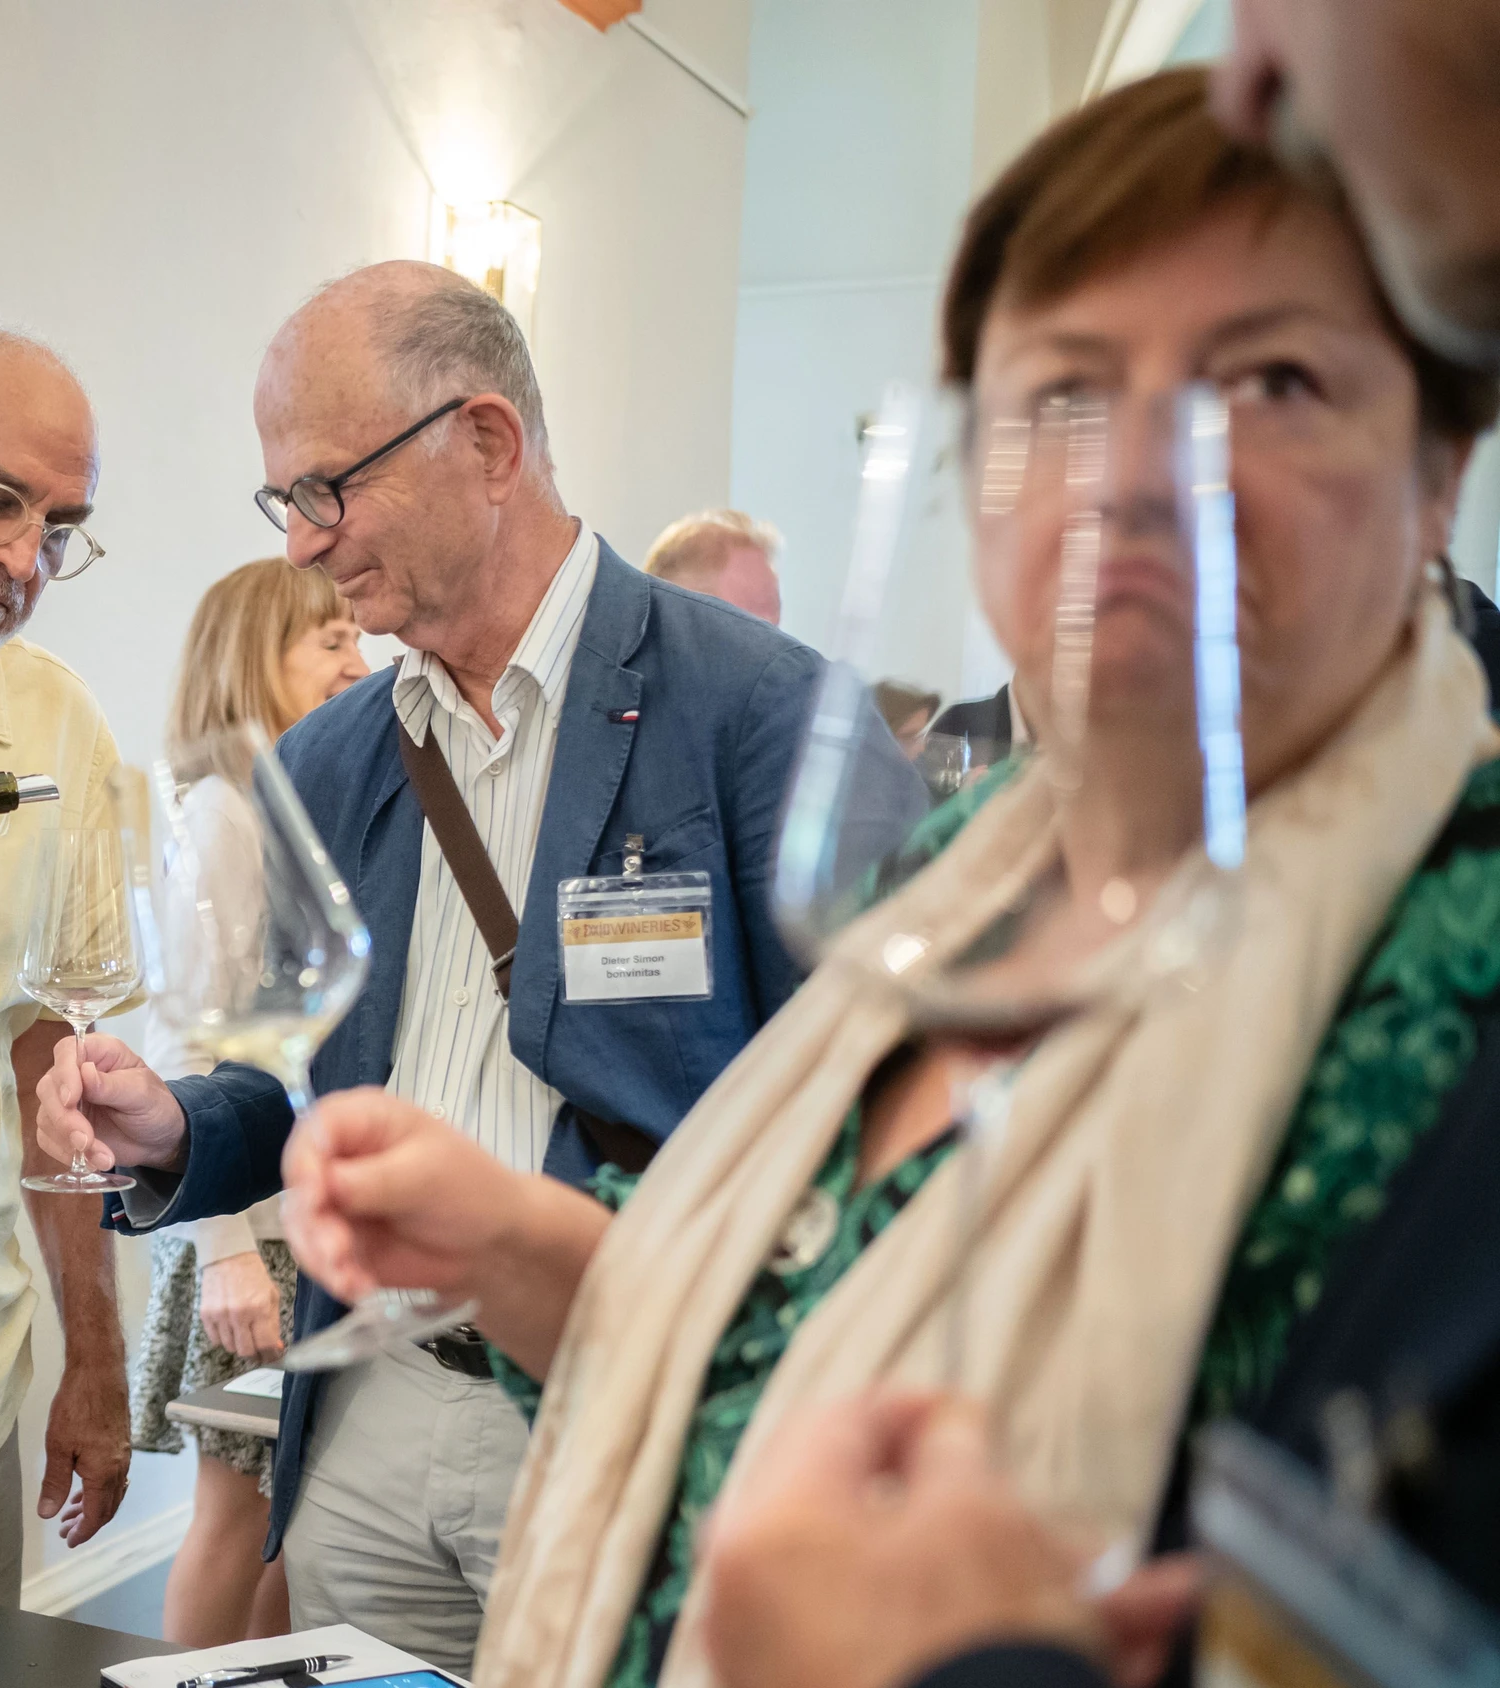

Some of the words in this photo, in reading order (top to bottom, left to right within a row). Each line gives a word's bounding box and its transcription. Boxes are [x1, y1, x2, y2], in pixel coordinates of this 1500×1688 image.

[601, 957, 630, 966] Dieter
[633, 955, 665, 964] Simon
[606, 968, 661, 979] bonvinitas
